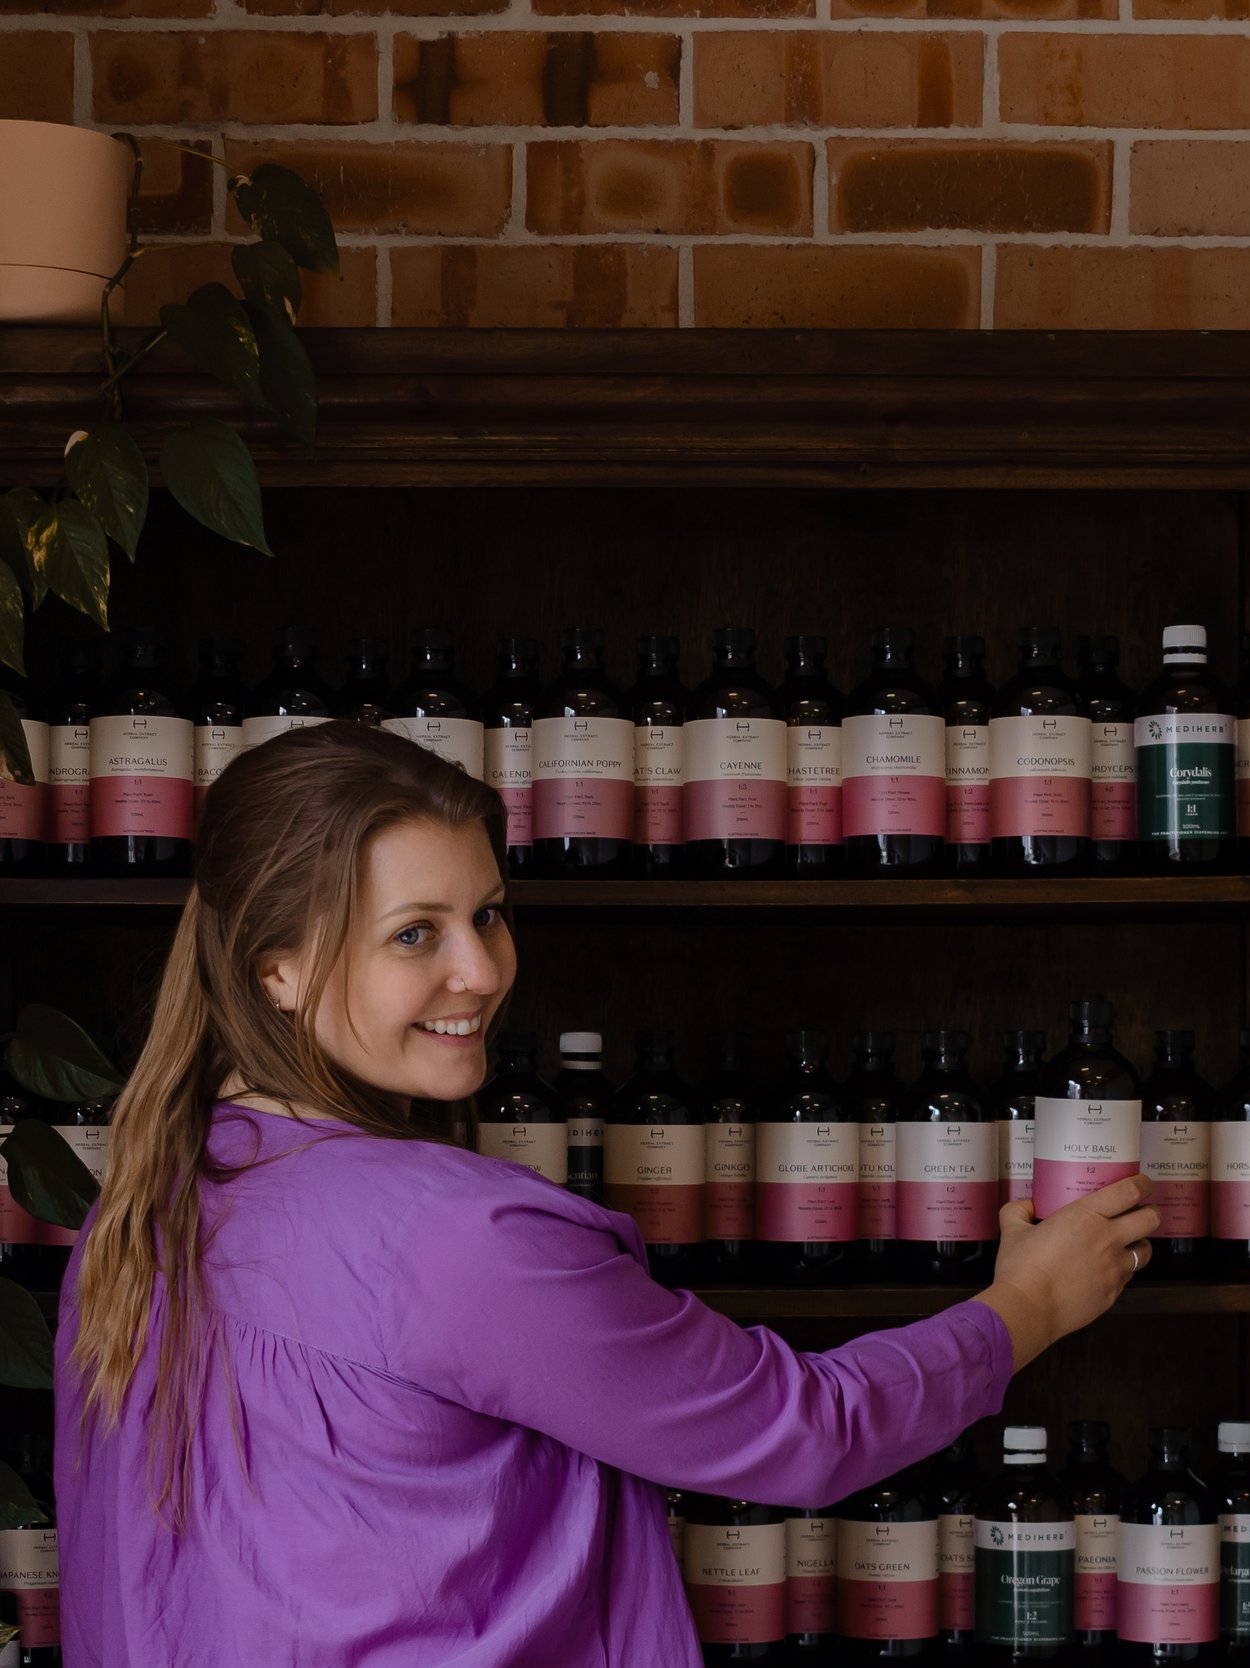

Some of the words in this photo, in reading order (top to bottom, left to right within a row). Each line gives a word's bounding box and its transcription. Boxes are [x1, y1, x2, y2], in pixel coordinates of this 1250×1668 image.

[109, 757, 168, 766] ASTRAGALUS
[866, 755, 920, 764] CHAMOMILE
[1017, 758, 1075, 766] CODONOPSIS
[538, 760, 593, 768] CALIFORNIAN
[597, 760, 622, 769] POPPY
[720, 762, 762, 770] CAYENNE
[50, 768, 90, 776] NDROGR
[198, 768, 222, 776] BACO
[492, 770, 532, 778] CALENDU
[632, 768, 654, 776] AT'S
[656, 768, 682, 776] CLAW
[788, 768, 840, 776] HASTETREE
[1170, 766, 1212, 779] Corydalis
[1064, 1144, 1089, 1152] HOLY
[1092, 1144, 1116, 1153] BASIL
[637, 1166, 672, 1174] GINGER
[714, 1164, 750, 1172] GINKGO
[778, 1164, 808, 1172] GLOBE
[878, 1164, 894, 1172] KOL
[1005, 1162, 1032, 1170] GYMN
[1147, 1162, 1208, 1170] HORSERADISH
[797, 1560, 834, 1568] NIGELLA
[1078, 1556, 1116, 1564] PAEONIA
[878, 1563, 910, 1571] GREEN
[1136, 1566, 1172, 1575] PASSION
[1176, 1567, 1209, 1575] FLOWER
[702, 1568, 736, 1576] NETTLE
[738, 1568, 760, 1576] LEAF
[1001, 1574, 1034, 1588] Oregon
[1036, 1576, 1060, 1587] Grape
